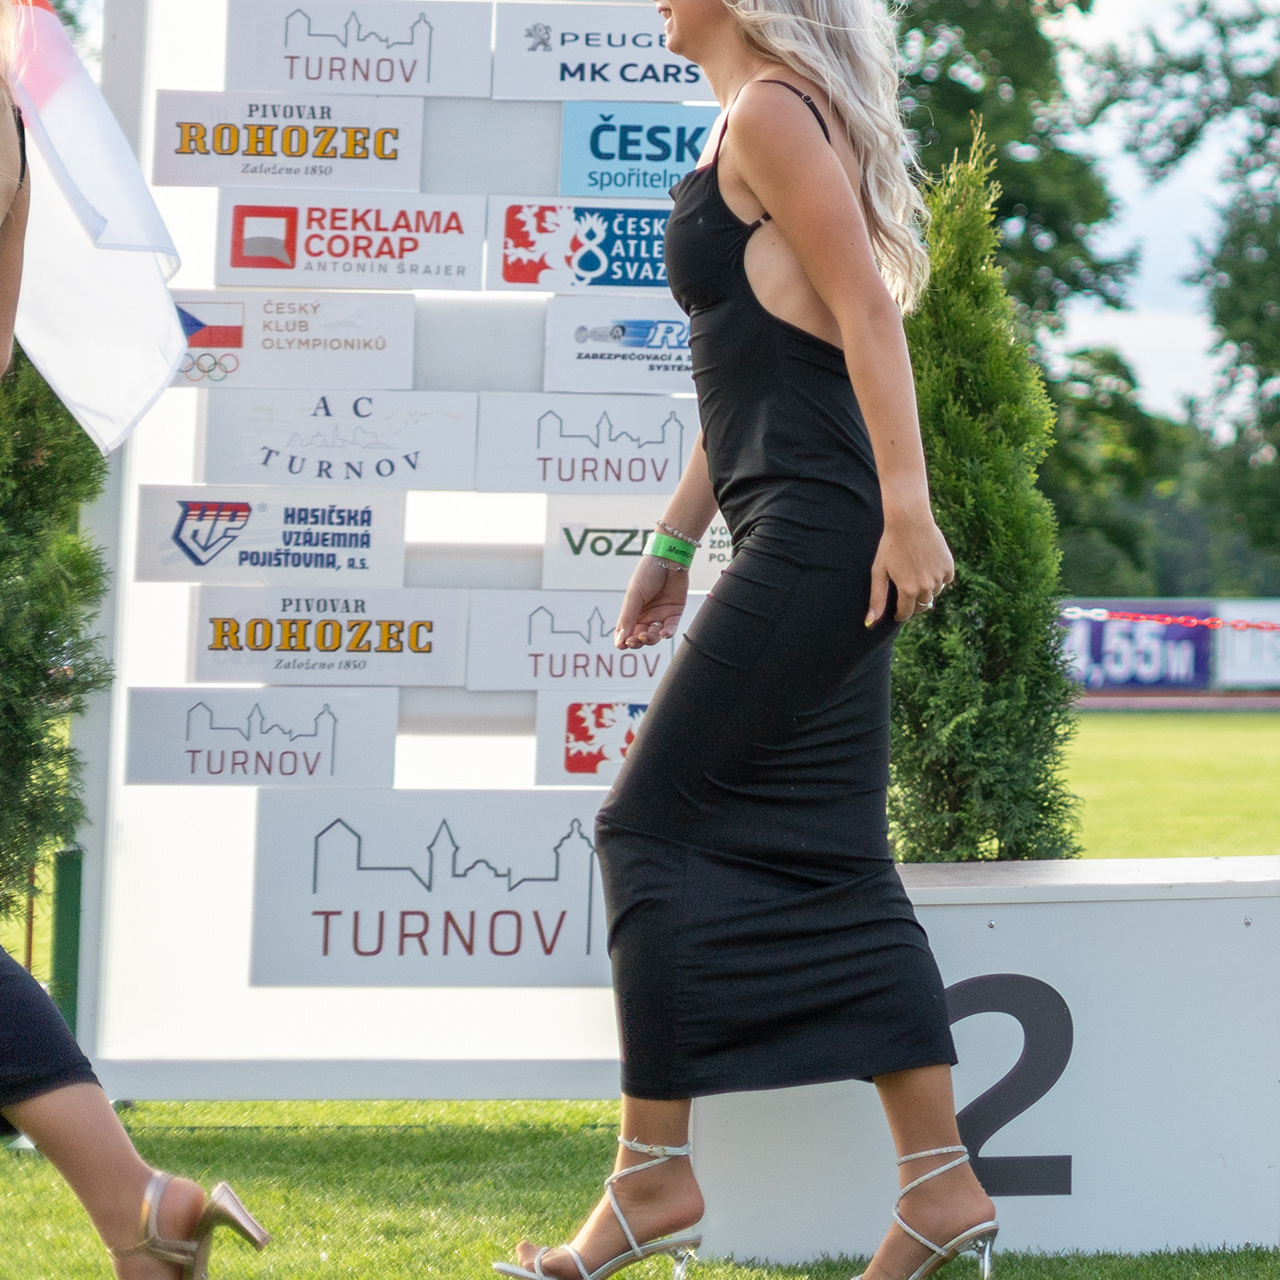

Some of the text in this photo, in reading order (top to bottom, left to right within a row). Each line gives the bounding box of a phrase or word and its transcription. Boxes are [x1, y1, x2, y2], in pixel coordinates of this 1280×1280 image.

[560, 31, 667, 49] PEUG
[283, 55, 417, 84] TURNOV
[559, 62, 701, 84] MK CARS
[247, 103, 333, 120] PIVOVAR
[175, 121, 399, 161] ROHOZEC
[589, 113, 707, 163] ČESK
[587, 167, 682, 191] spořiteln
[305, 206, 465, 235] REKLAMA
[612, 213, 667, 236] ČESK
[304, 233, 420, 260] CORAP
[303, 260, 467, 277] ANTONÍN ŠRAJER
[262, 299, 321, 316] ČESKÝ
[262, 319, 310, 333] KLUB
[261, 336, 387, 352] OLYMPIONIKŮ
[648, 363, 693, 372] SYSTÉM
[310, 395, 373, 418] A C
[259, 445, 422, 481] TURNOV
[536, 457, 670, 482] TURNOV
[283, 504, 373, 527] HASIČSKÁ
[282, 528, 371, 549] VZÁJEMNÁ
[238, 548, 342, 571] POJIŠŤOVNA,
[281, 598, 366, 614] PIVOVAR
[208, 617, 433, 654] ROHOZEC
[273, 658, 334, 671] Založeno
[528, 652, 661, 679] TURNOV
[185, 749, 323, 777] TURNOV
[311, 909, 568, 958] TURNOV
[944, 973, 1075, 1197] 2
